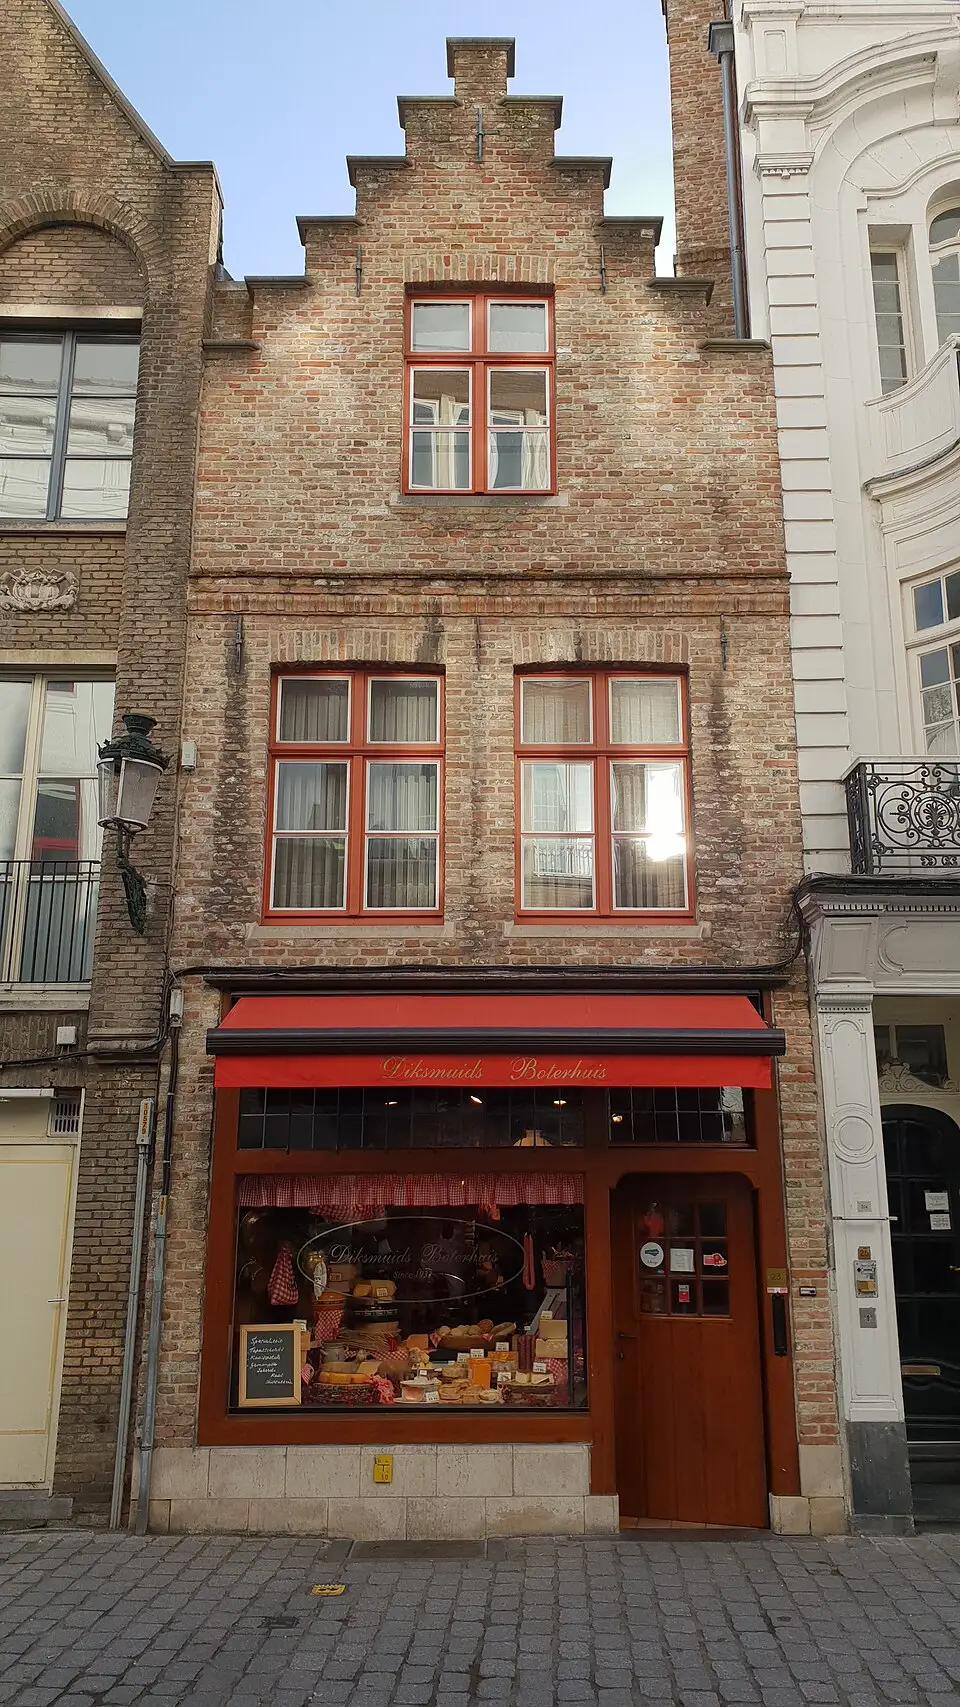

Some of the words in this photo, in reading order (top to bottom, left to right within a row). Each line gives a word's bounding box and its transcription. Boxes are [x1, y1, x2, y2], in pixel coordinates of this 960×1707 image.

[381, 1056, 484, 1080] Diksmuids
[509, 1056, 608, 1081] Boterhuis
[328, 1243, 411, 1264] Diksmuids
[421, 1243, 499, 1264] Boterhuis
[770, 1272, 782, 1281] 23
